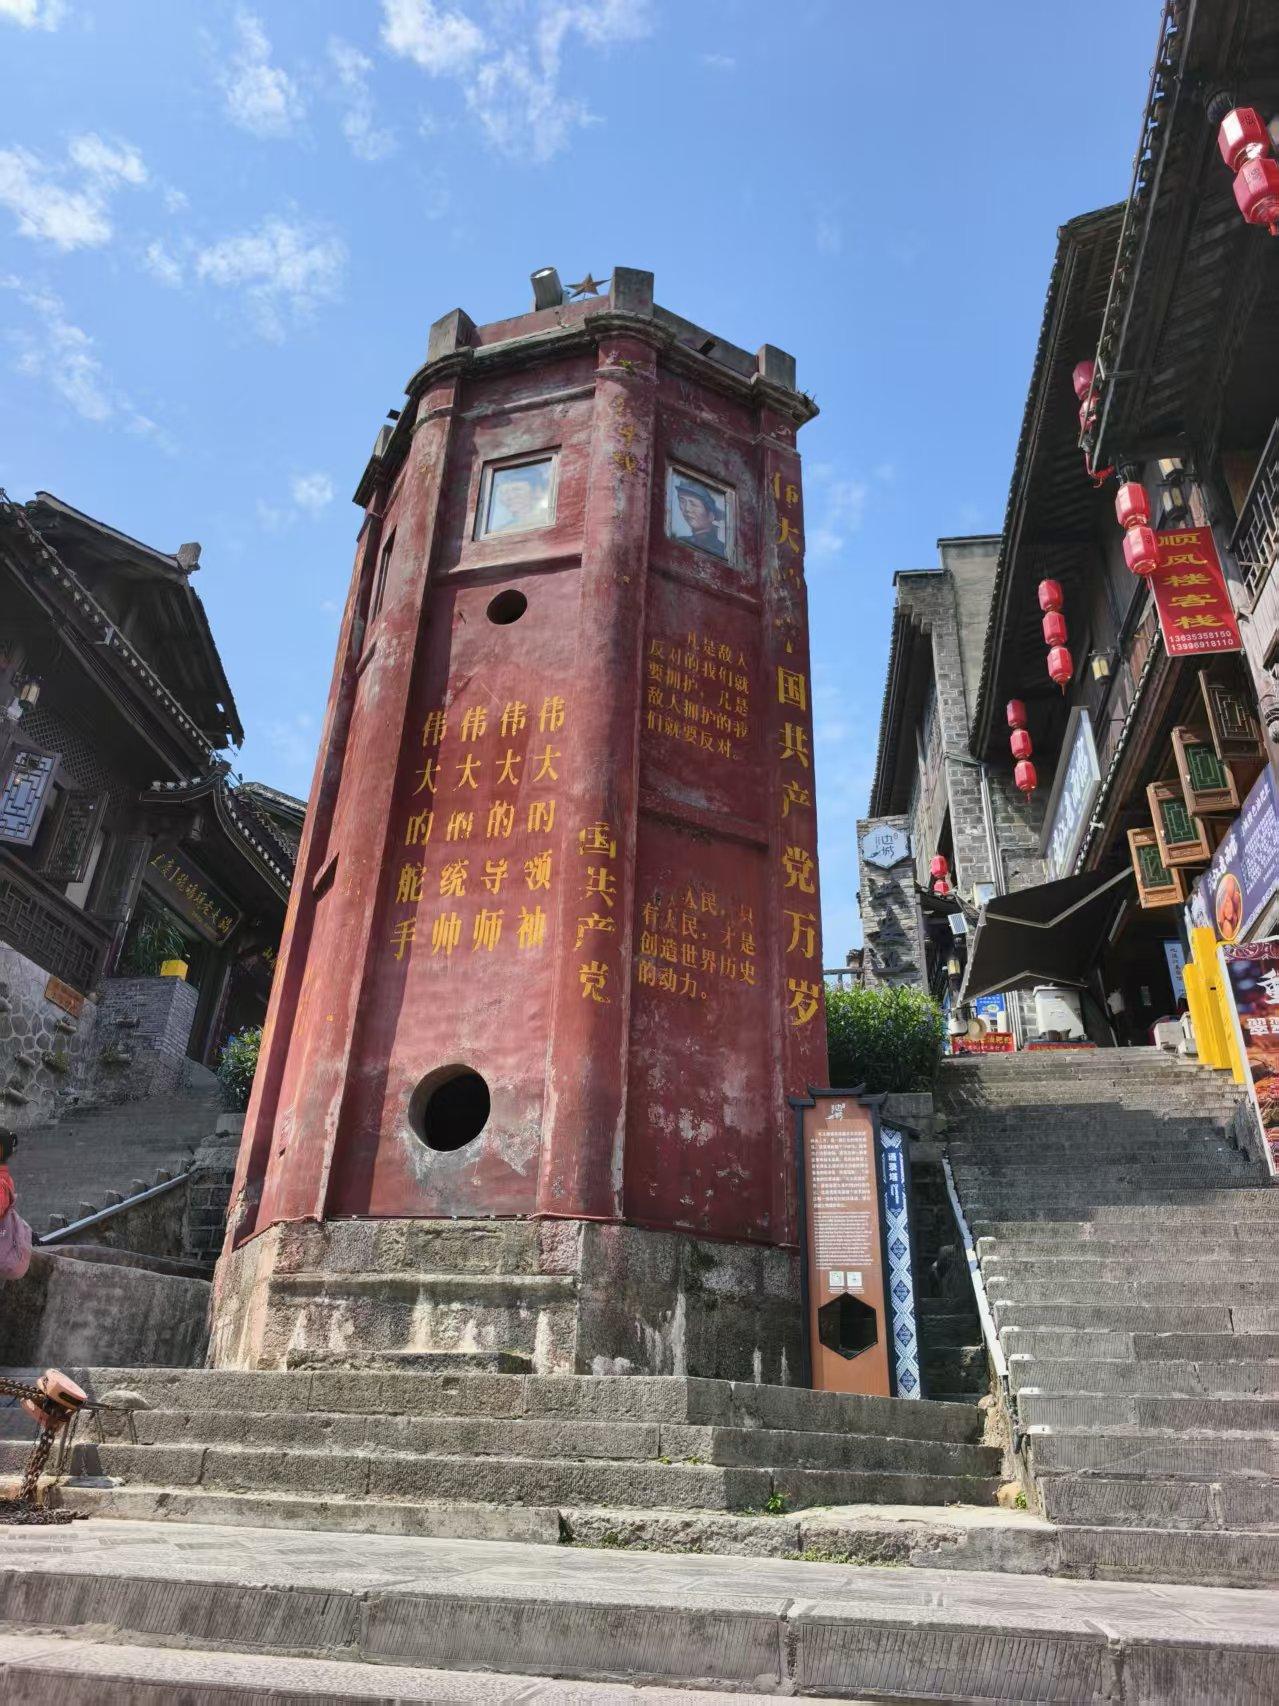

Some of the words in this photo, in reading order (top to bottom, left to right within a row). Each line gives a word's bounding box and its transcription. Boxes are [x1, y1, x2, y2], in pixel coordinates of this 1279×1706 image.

[1158, 532, 1225, 629] 顺风楼客栈
